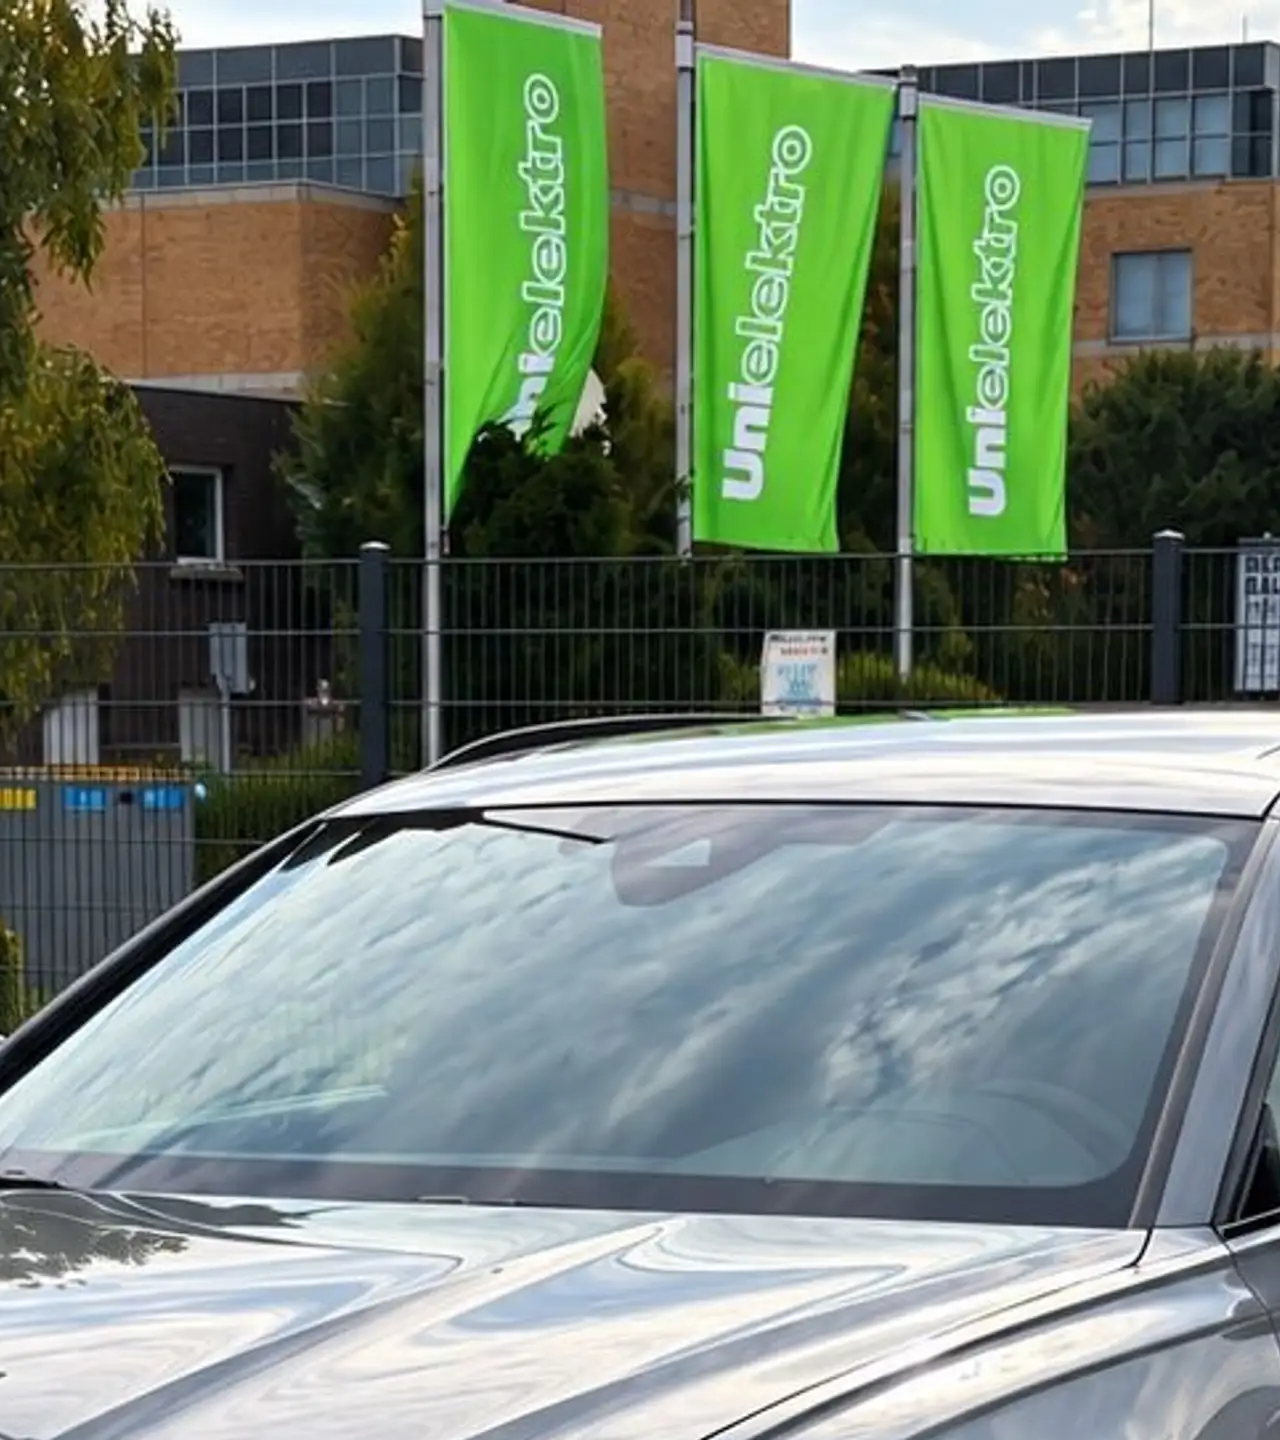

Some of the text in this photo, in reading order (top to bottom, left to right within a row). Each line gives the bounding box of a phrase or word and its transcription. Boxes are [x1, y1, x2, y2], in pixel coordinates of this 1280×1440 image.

[497, 73, 568, 441] nielektro
[722, 124, 813, 500] Unielektro
[965, 164, 1021, 517] Unielektro
